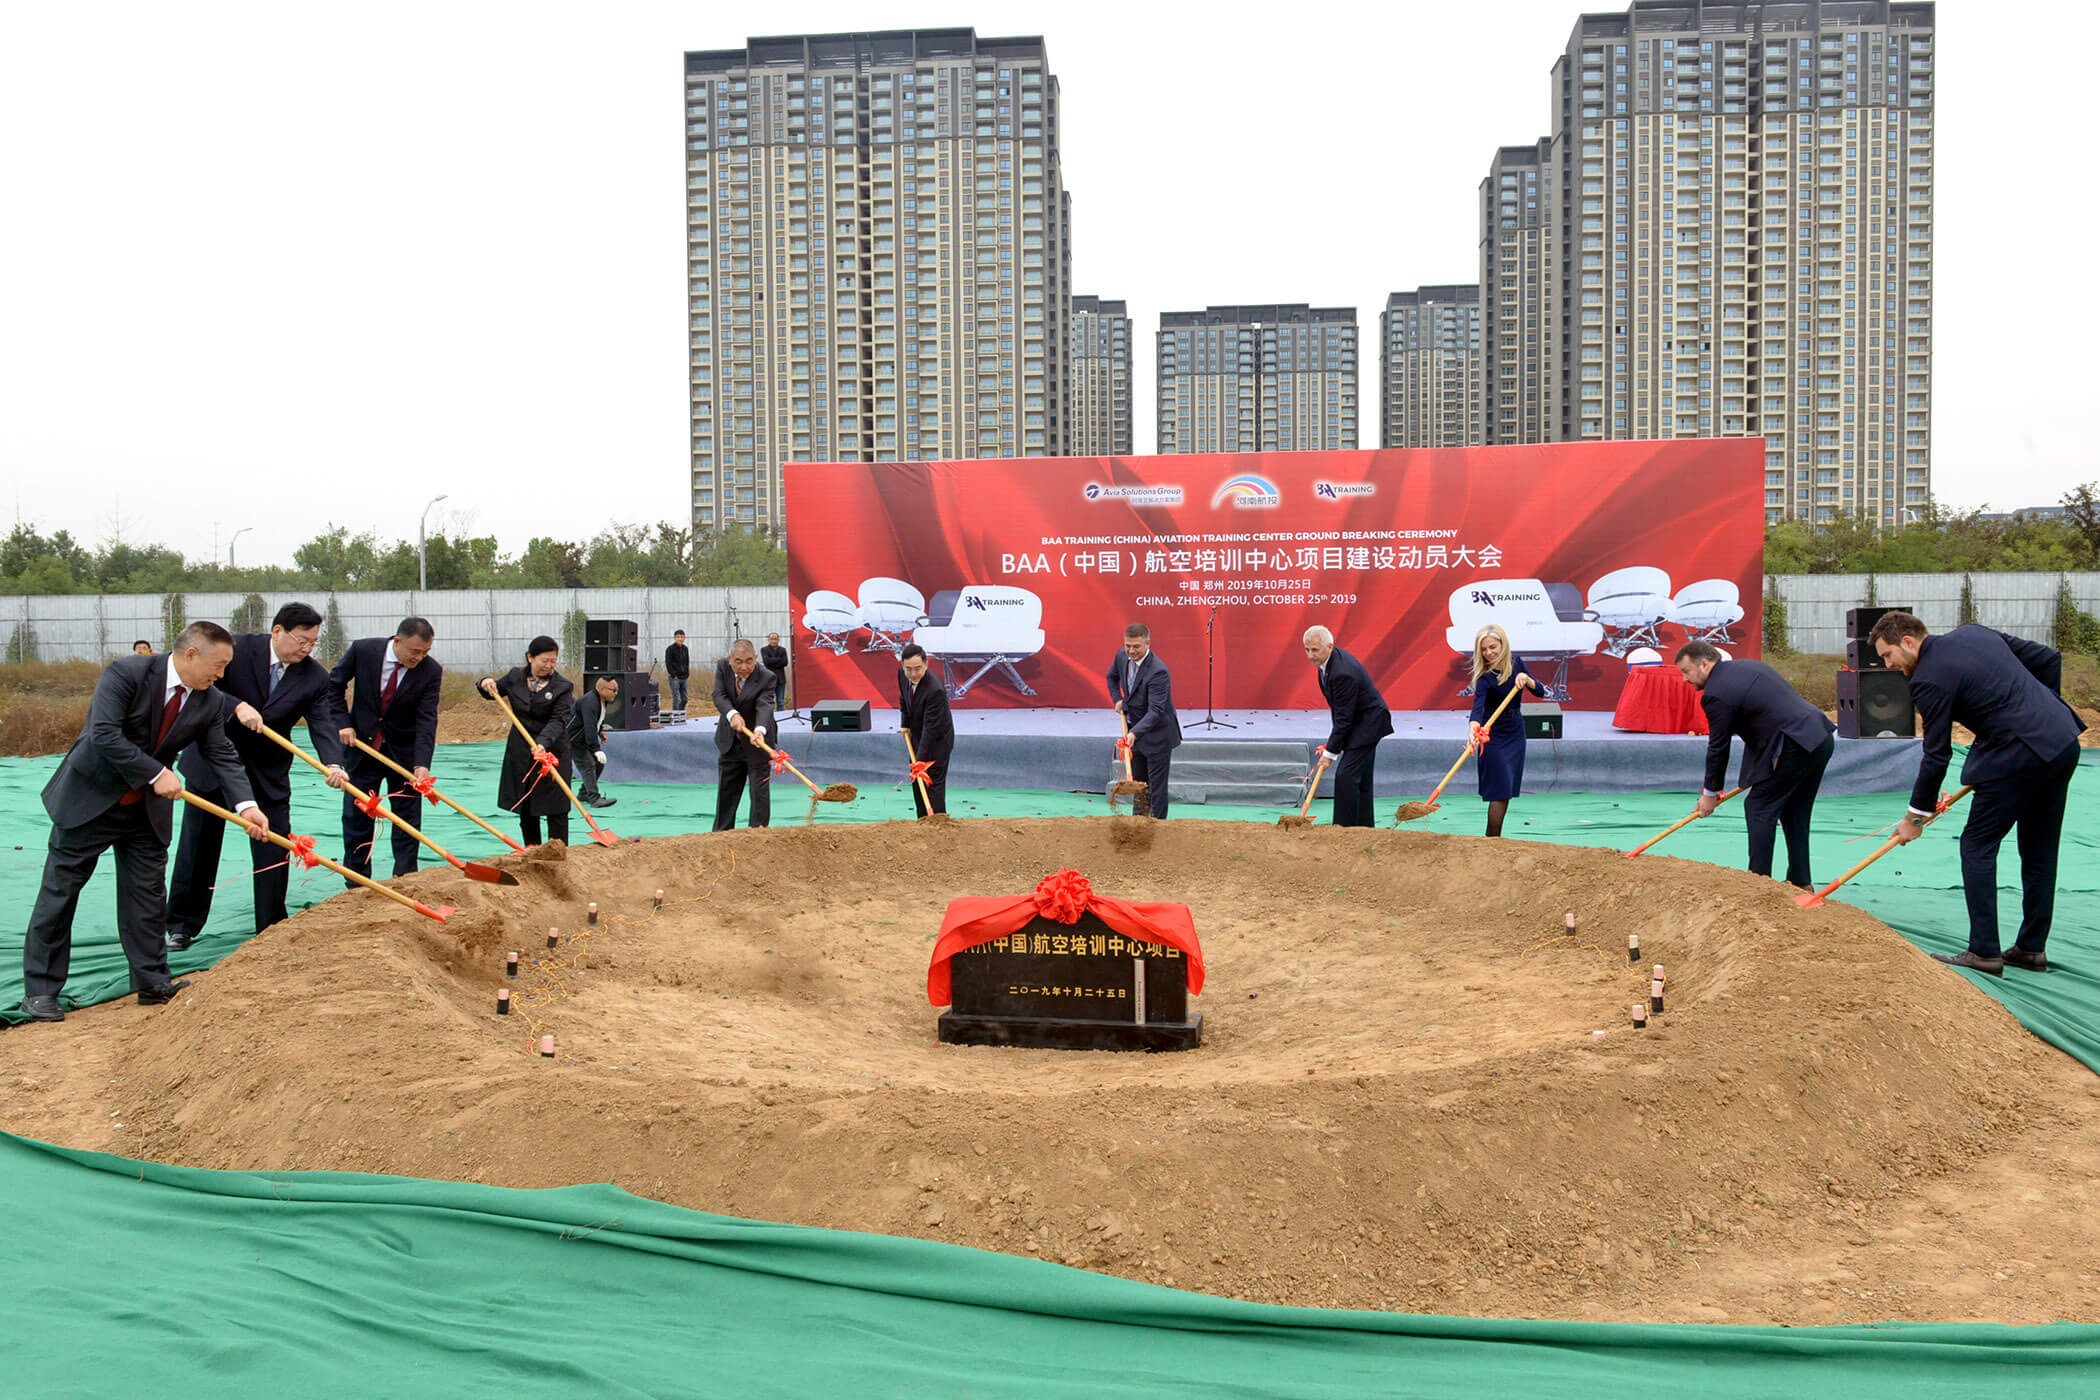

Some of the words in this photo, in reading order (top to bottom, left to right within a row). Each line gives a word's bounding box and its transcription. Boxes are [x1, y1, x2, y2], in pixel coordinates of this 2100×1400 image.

[1103, 488, 1120, 496] Avia
[1121, 487, 1156, 496] Solutions
[1157, 487, 1181, 496] Group
[1333, 486, 1373, 494] TRAINING
[1041, 536, 1063, 545] BAA
[1064, 535, 1112, 545] TRAINING
[1113, 534, 1151, 545] (CHINA)
[1153, 534, 1201, 544] AVIATION
[1202, 533, 1251, 543] TRAINING
[1252, 532, 1294, 541] CENTER
[1295, 531, 1341, 541] GROUND
[1342, 530, 1396, 540] BREAKING
[1397, 529, 1458, 539] CEREMONY
[1179, 580, 1200, 591] 中国
[1203, 580, 1224, 591] 郑州
[1227, 579, 1311, 591] 2019年10月25日
[1135, 596, 1174, 607] CHINA,
[1176, 595, 1250, 607] ZHENGZHOU,
[1252, 595, 1305, 606] OCTOBER
[1307, 594, 1328, 605] 25th
[1330, 593, 1358, 605] 2019
[1491, 593, 1541, 601] TRAINING
